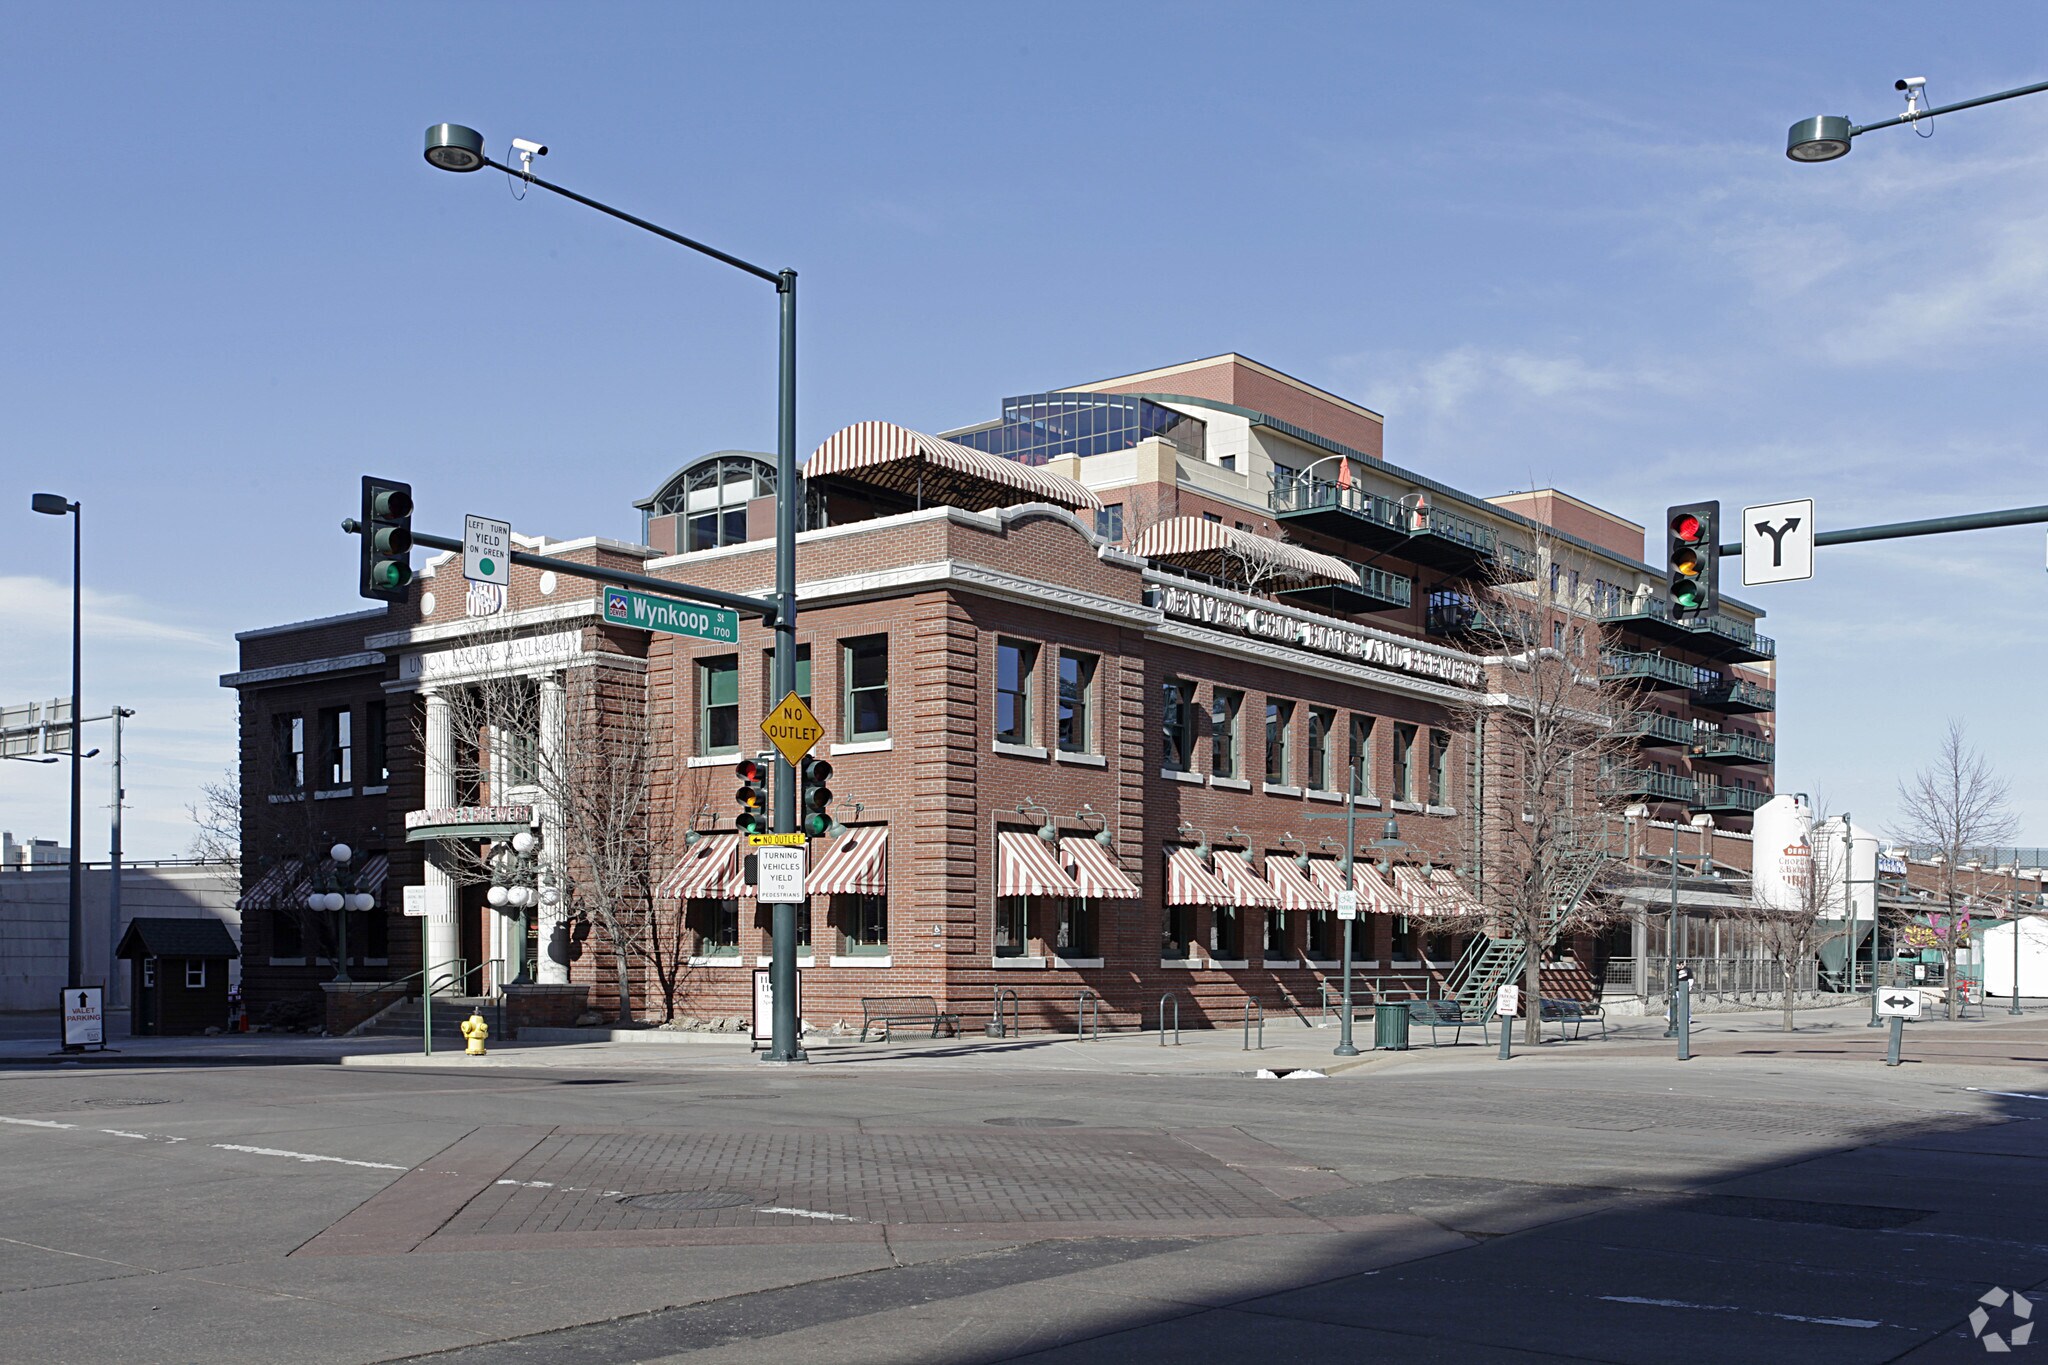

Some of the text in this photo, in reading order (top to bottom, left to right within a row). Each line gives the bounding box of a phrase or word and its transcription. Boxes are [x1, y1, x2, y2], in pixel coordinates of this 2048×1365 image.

[468, 520, 508, 535] LEFT TURN
[476, 533, 500, 546] YIELD
[470, 545, 504, 558] ON GREEN
[610, 608, 628, 618] DENVER
[633, 597, 725, 635] Wynkoop St
[713, 627, 730, 638] 1700
[1152, 584, 1247, 629] DENVER
[1247, 608, 1302, 642] CHOP
[1301, 622, 1363, 657] HOUSE
[1363, 638, 1404, 667] AND
[409, 633, 570, 673] UNION PACIFIC RAILROAD
[784, 708, 802, 721] NO
[770, 725, 816, 741] OUTLET
[473, 805, 531, 822] BREWERY
[763, 835, 800, 844] NO OUTLET
